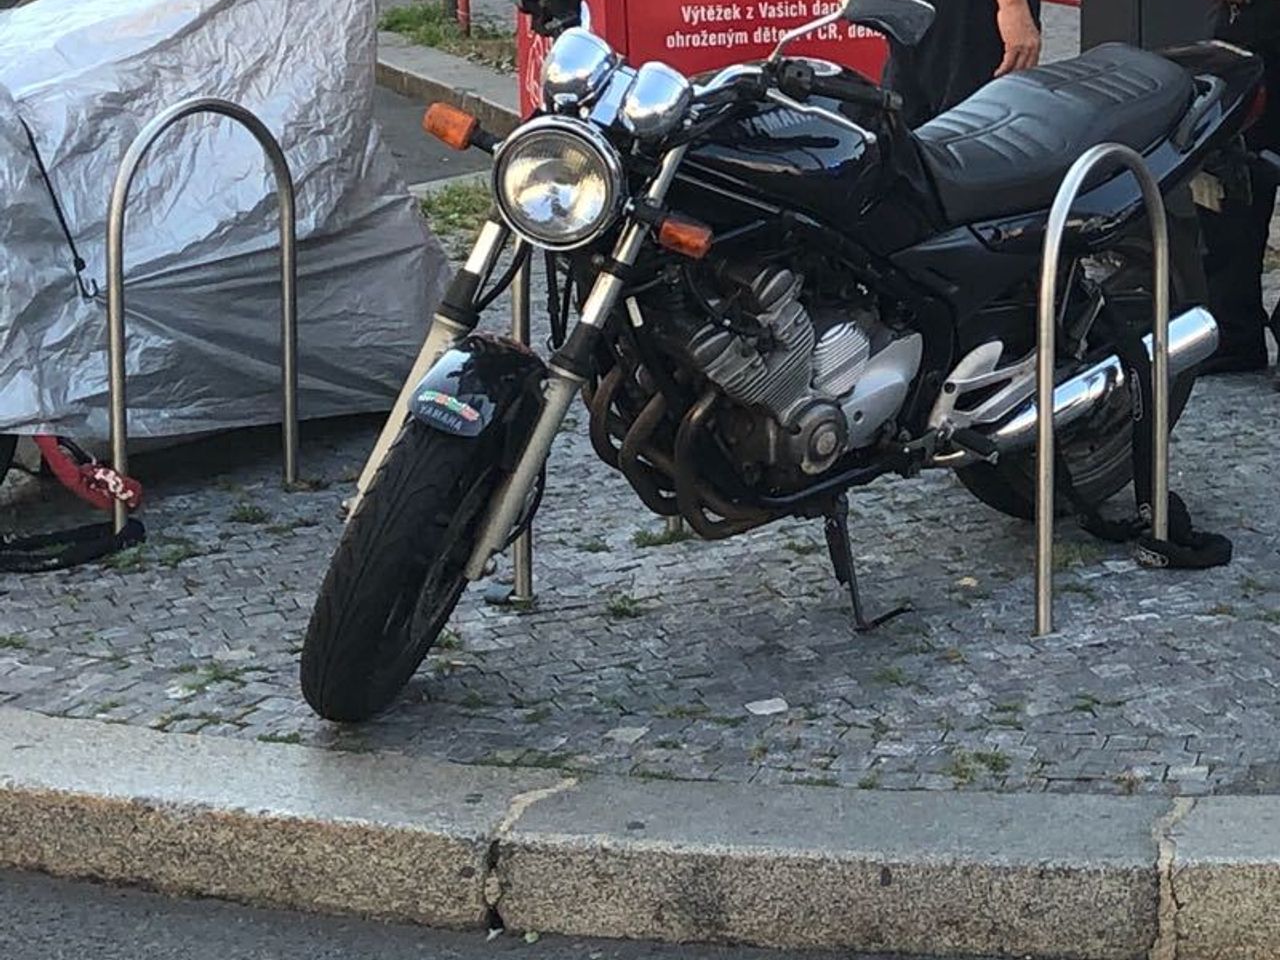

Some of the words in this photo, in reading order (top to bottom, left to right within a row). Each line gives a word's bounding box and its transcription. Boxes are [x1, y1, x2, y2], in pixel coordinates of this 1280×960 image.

[681, 2, 742, 25] Výtěžek
[746, 8, 754, 20] z
[666, 30, 750, 49] ohroženým
